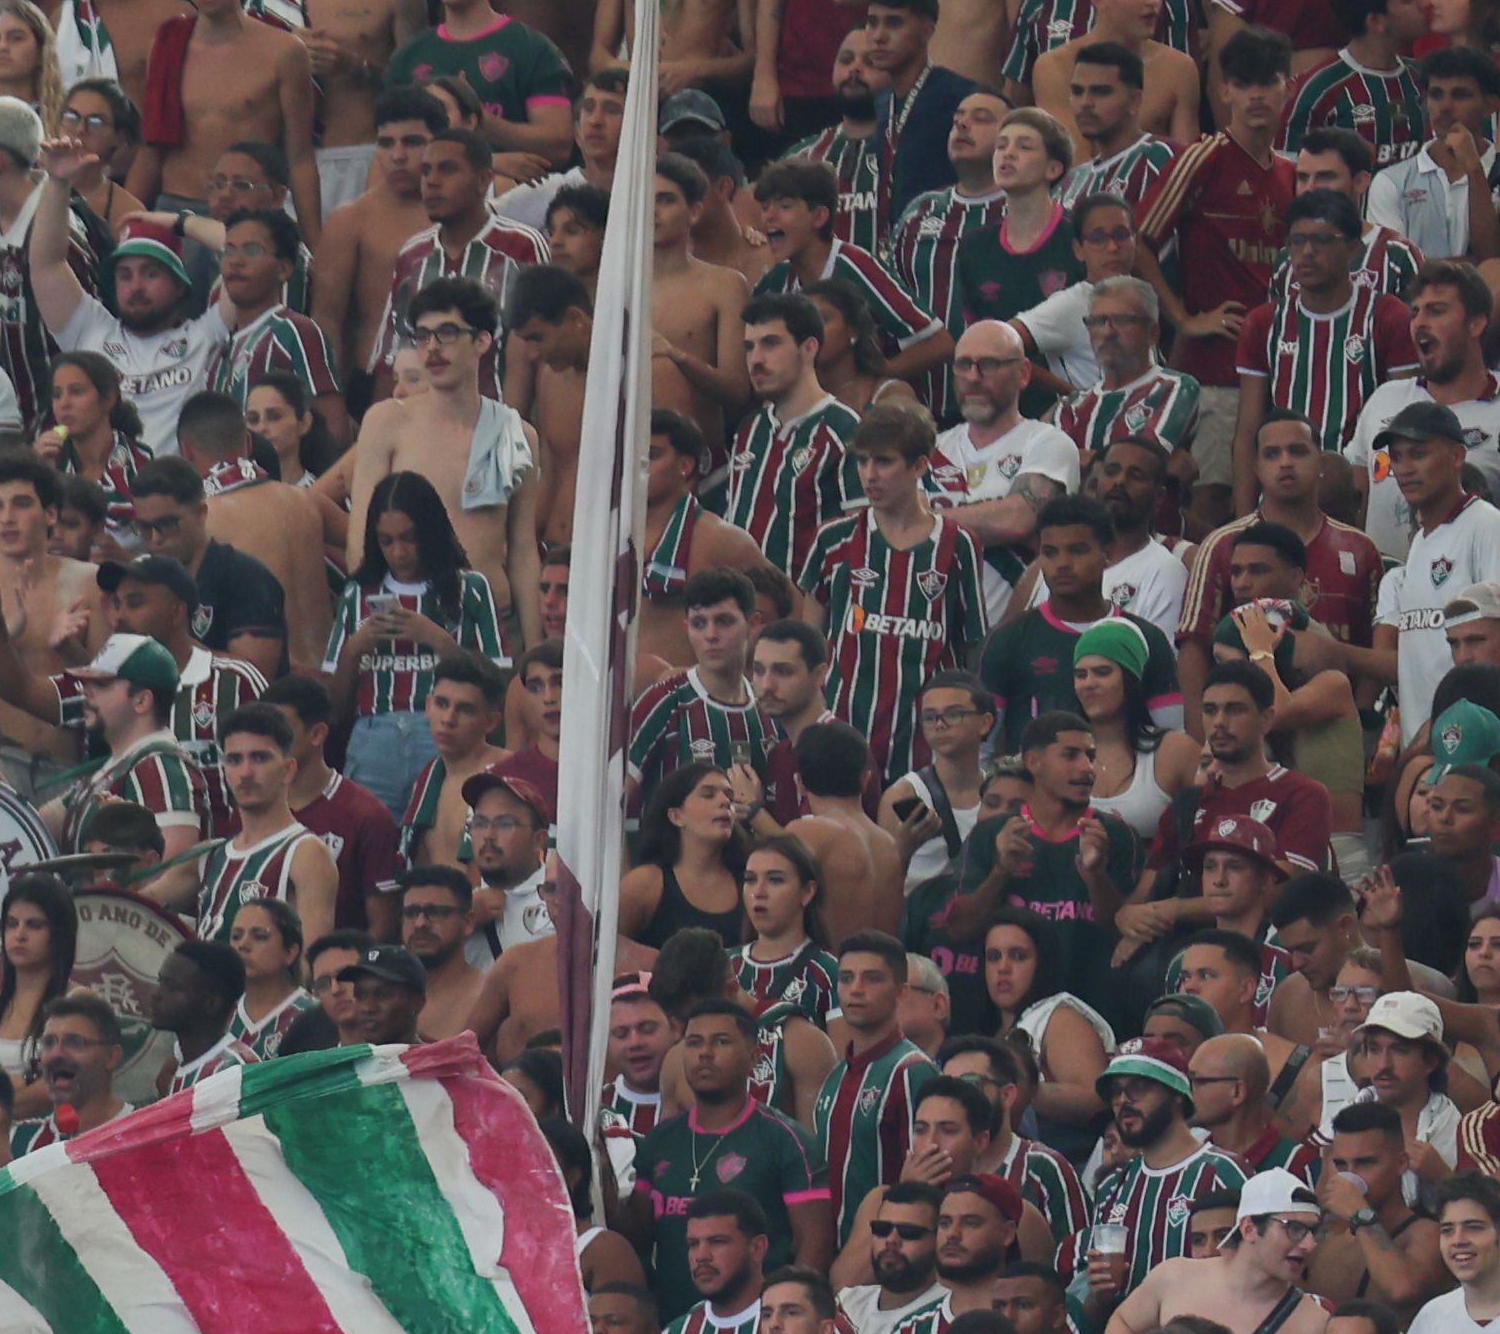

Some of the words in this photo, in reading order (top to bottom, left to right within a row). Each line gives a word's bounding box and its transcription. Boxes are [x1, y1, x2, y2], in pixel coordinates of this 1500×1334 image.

[865, 612, 946, 641] BETANO
[105, 905, 142, 934] ANO
[144, 921, 171, 947] DE
